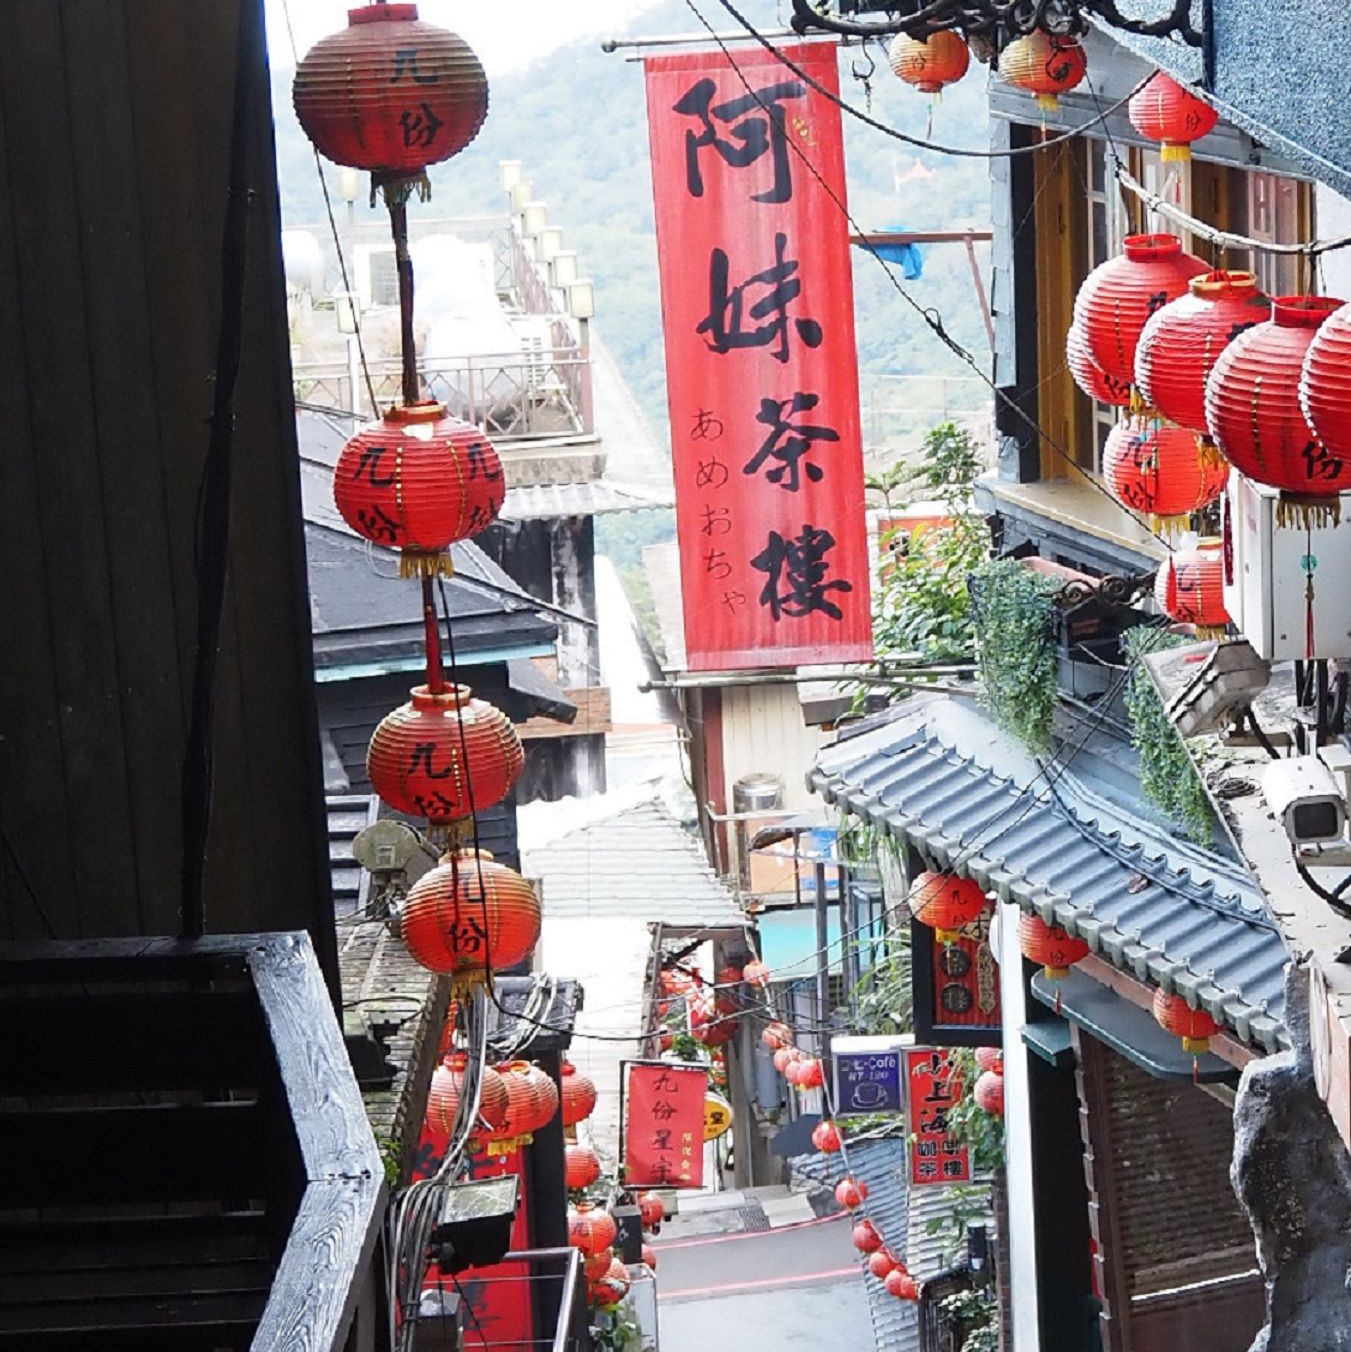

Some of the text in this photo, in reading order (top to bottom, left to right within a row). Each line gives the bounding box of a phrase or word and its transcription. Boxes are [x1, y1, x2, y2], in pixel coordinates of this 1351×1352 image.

[391, 50, 443, 147] 九份
[673, 78, 853, 622] 阿妹茶樓
[353, 446, 402, 544] 九份
[407, 742, 456, 817] 九份
